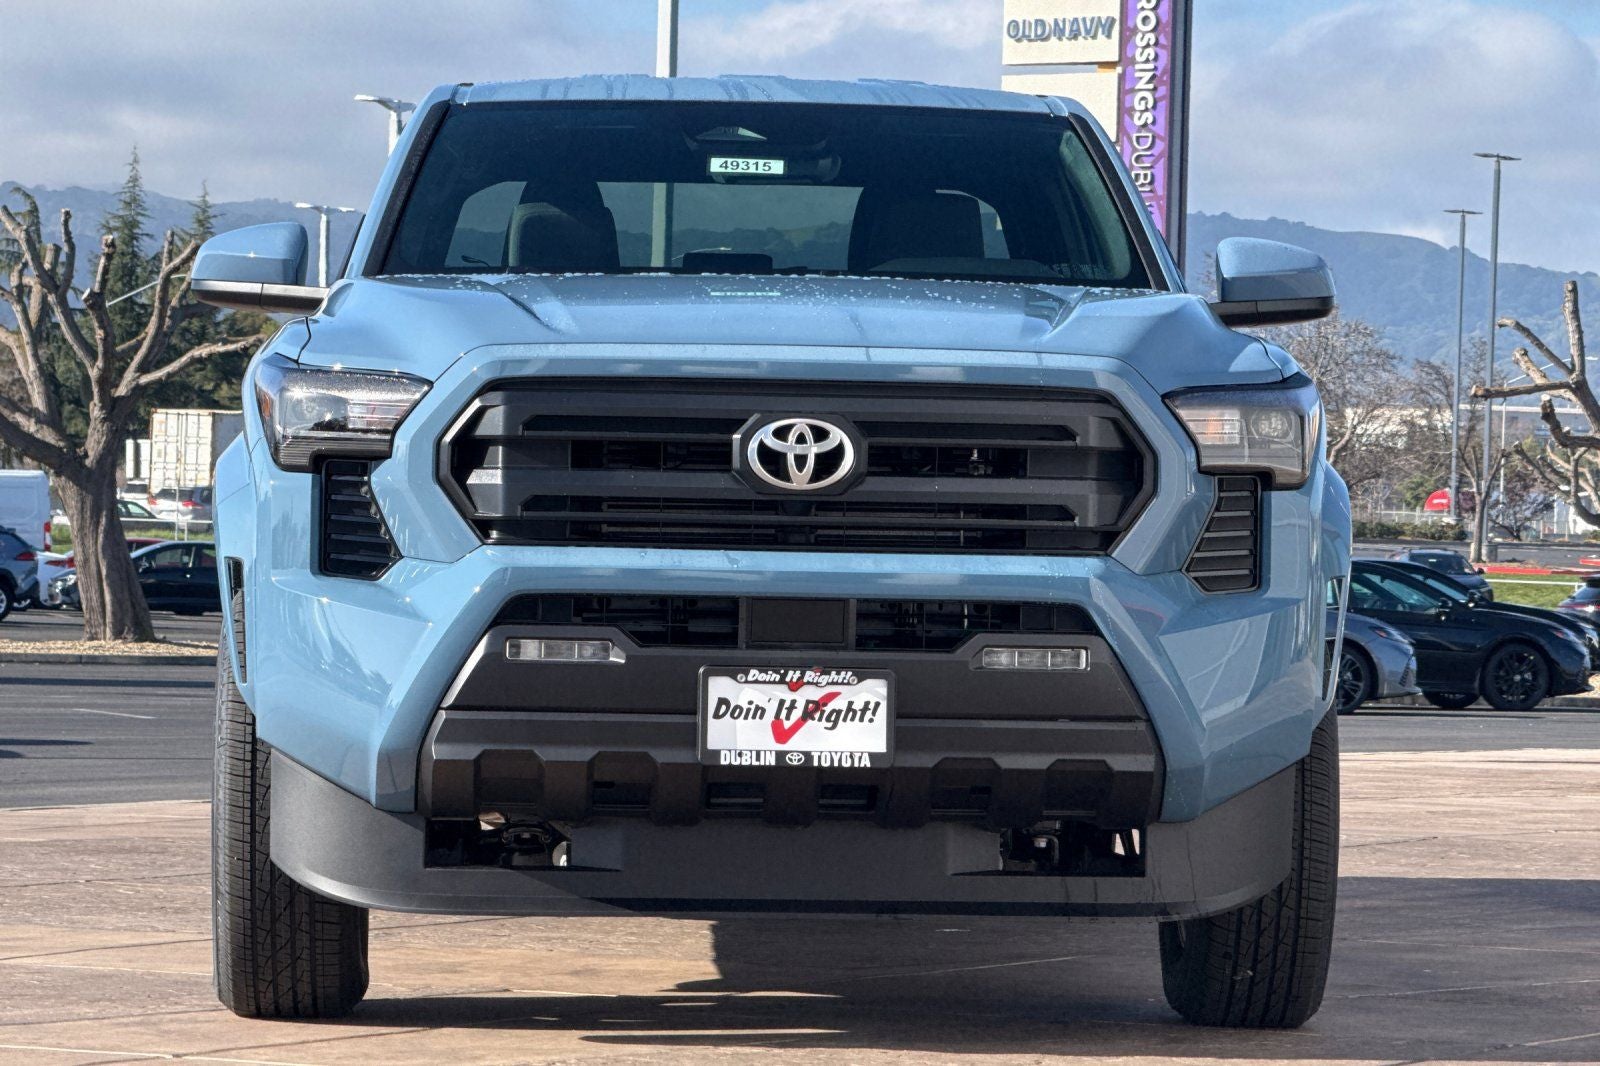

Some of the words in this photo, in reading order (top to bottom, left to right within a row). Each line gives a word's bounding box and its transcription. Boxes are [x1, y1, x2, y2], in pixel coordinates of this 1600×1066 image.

[1007, 18, 1051, 42] OLD
[1052, 16, 1116, 40] NAVY
[719, 160, 772, 172] 49315
[1131, 133, 1153, 206] DUB
[785, 670, 801, 683] It
[804, 671, 852, 686] Right!
[712, 697, 771, 721] Doin'
[774, 698, 798, 721] It
[801, 699, 881, 731] Right!
[720, 750, 776, 766] DUBLIN
[811, 751, 871, 768] TOYOTA
